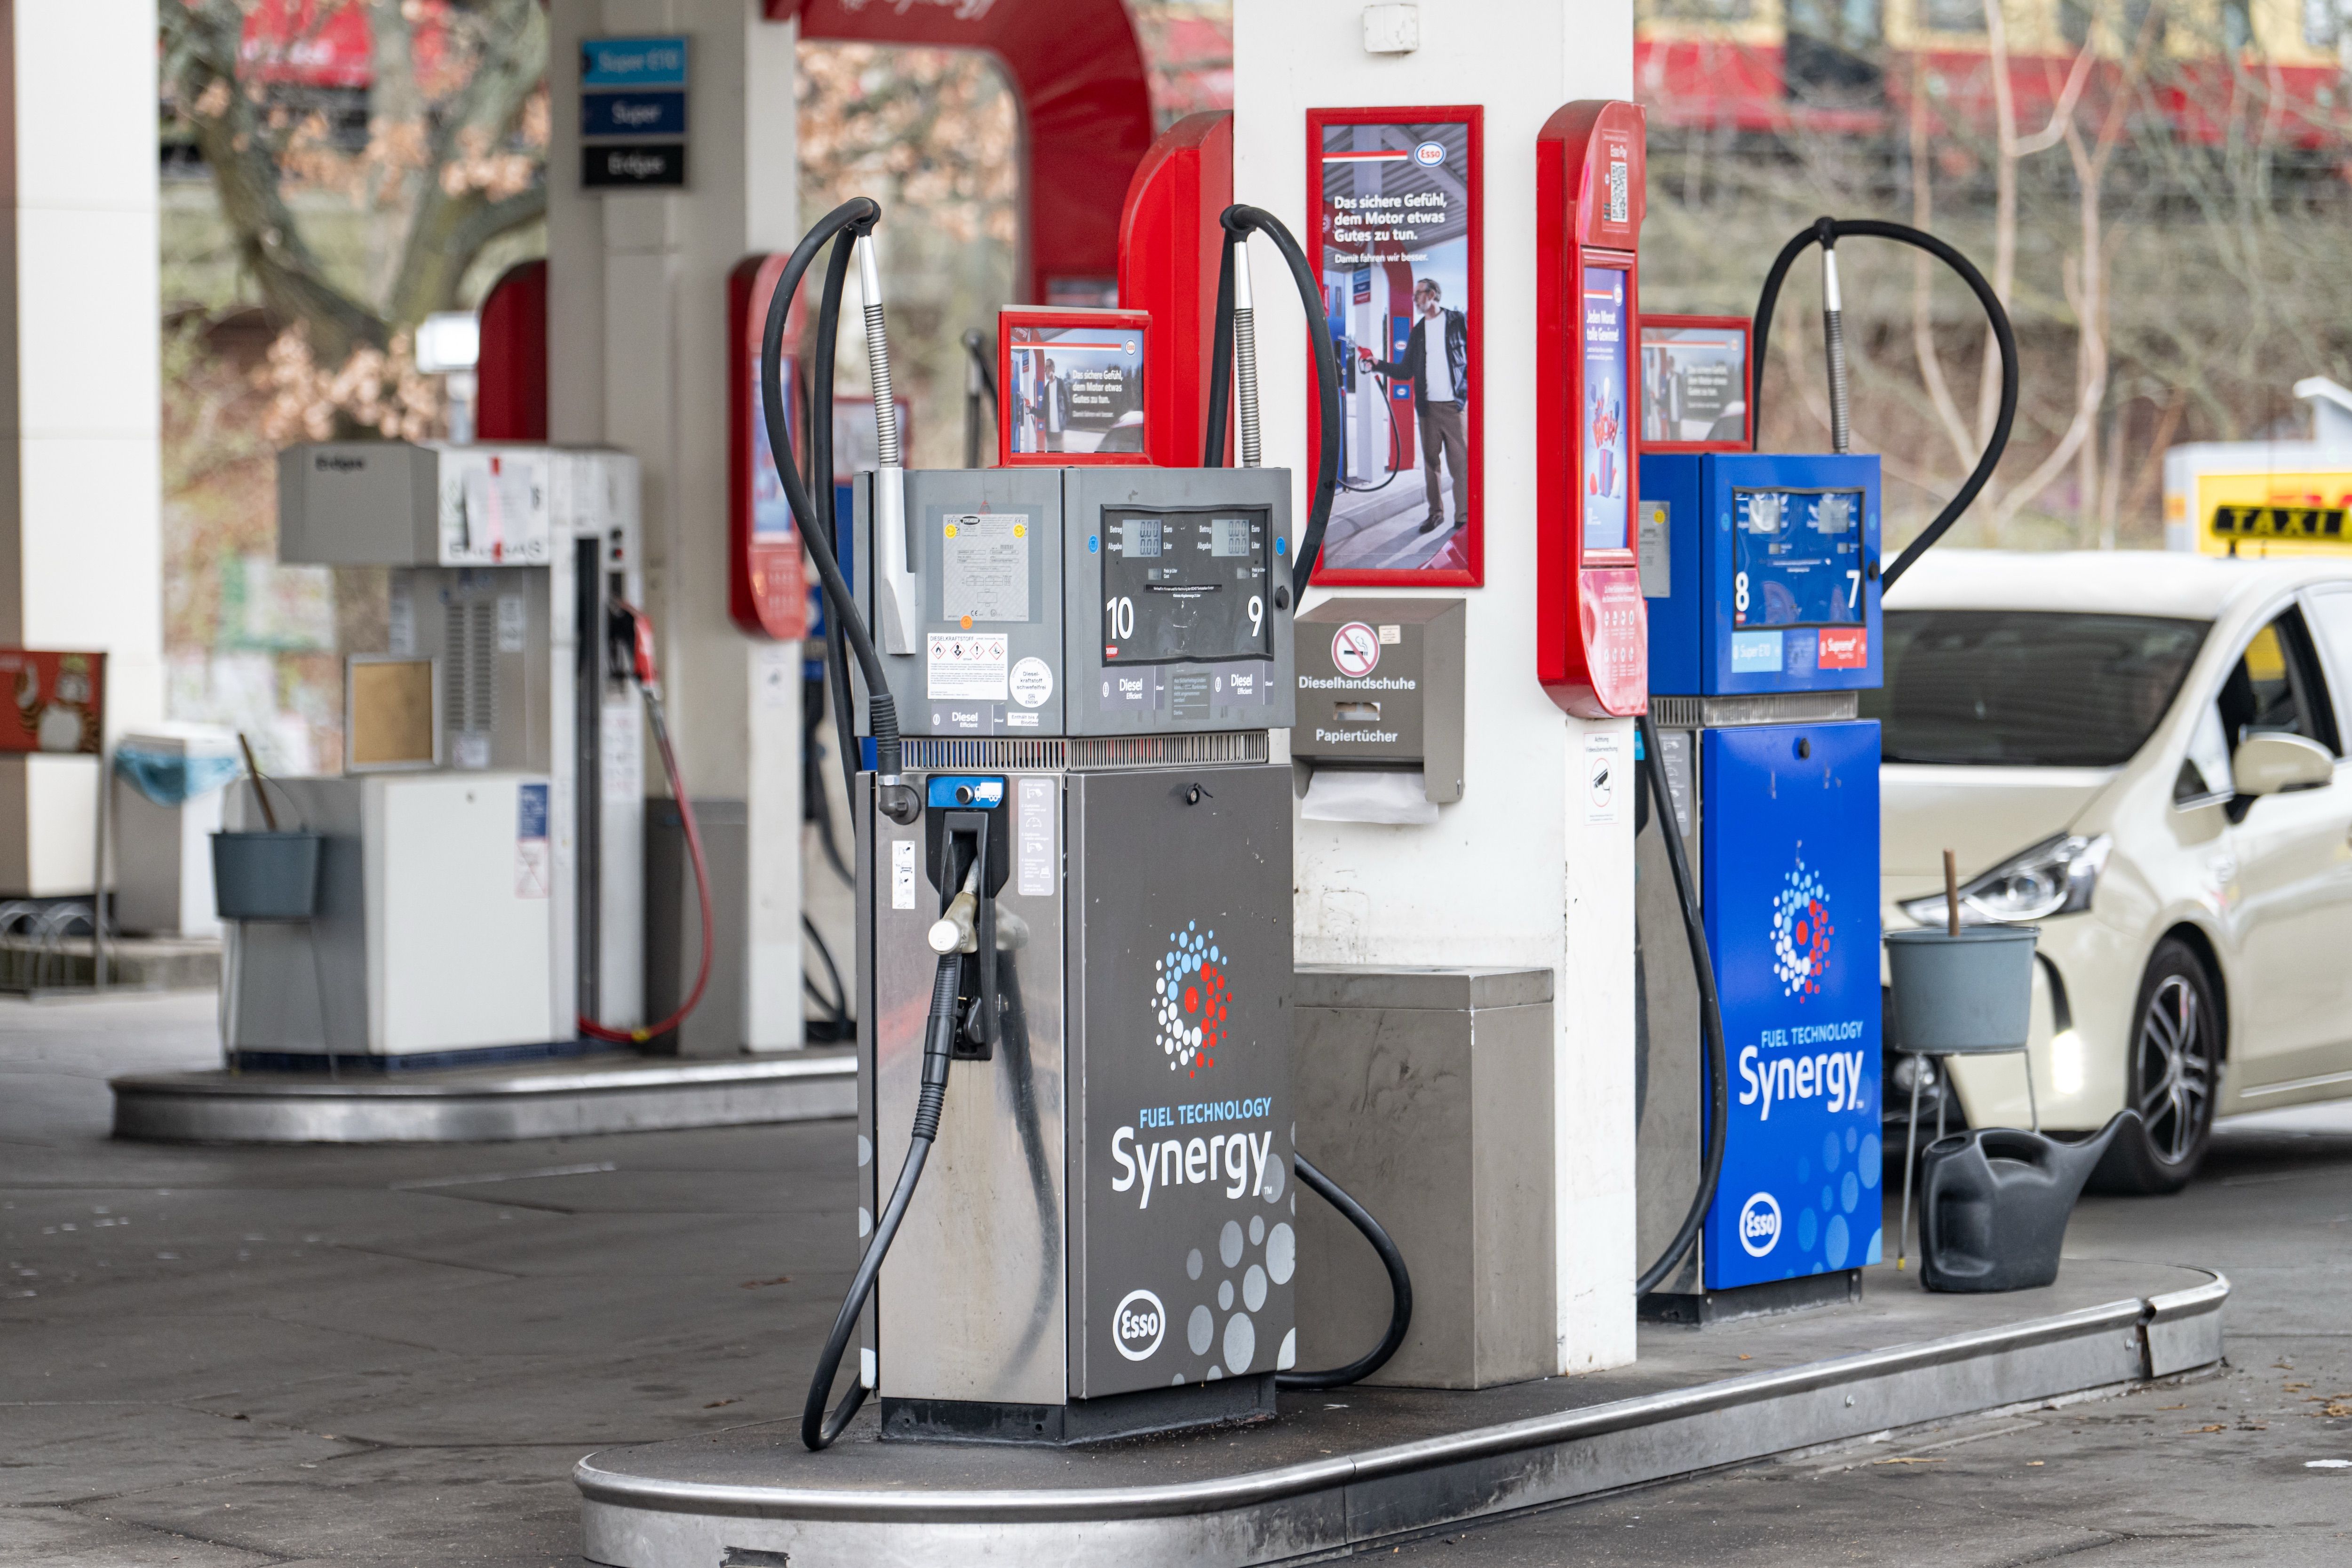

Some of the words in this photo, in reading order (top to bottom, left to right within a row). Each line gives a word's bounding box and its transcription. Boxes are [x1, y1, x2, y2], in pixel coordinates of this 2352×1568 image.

[598, 50, 644, 73] Super
[612, 100, 659, 125] Super
[1421, 149, 1440, 159] Esso
[1334, 196, 1357, 209] Das
[1359, 194, 1401, 208] sichere
[1404, 193, 1447, 208] Gefühl,
[1334, 213, 1362, 226] dem
[1365, 212, 1404, 224] Motor
[1406, 212, 1445, 223] etwas
[1334, 229, 1372, 242] Gutes
[1374, 232, 1390, 241] zu
[1392, 229, 1418, 241] tun.
[1335, 253, 1359, 263] Damit
[1360, 253, 1385, 263] fahren
[1401, 252, 1429, 262] besser.
[1073, 370, 1083, 379] Das
[1084, 369, 1103, 379] sichere
[1104, 370, 1123, 381] Gefühl,
[1073, 382, 1085, 391] dem
[1086, 382, 1104, 391] Motor
[1104, 383, 1122, 392] etwas
[1073, 393, 1089, 404] Gutes
[1098, 395, 1110, 404] tun.
[1110, 525, 1122, 534] Betrag
[1140, 522, 1159, 538] 0,00
[1199, 525, 1212, 534] Betrag
[1108, 542, 1122, 551] Abgabe
[1140, 539, 1159, 555] 0,00
[1197, 542, 1211, 550] Abgabe
[1735, 571, 1750, 612] 8
[1846, 570, 1861, 609] 7
[1106, 597, 1134, 639] 10
[1248, 595, 1263, 637] 9
[1120, 677, 1143, 692] Diesel
[1231, 674, 1253, 687] Diesel
[1298, 676, 1416, 690] Dieselhandschuhe
[952, 712, 978, 722] Diesel
[1316, 729, 1398, 744] Papiertücher
[1761, 1029, 1788, 1049] FUEL
[1790, 1020, 1863, 1046] TECHNOLOGY
[1739, 1044, 1864, 1122] Synergy
[1139, 1107, 1175, 1129] FUEL
[1178, 1097, 1272, 1125] TECHNOLOGY
[1112, 1126, 1272, 1210] Synergy
[1746, 1210, 1775, 1238] Esso
[1121, 1310, 1158, 1340] Esso
